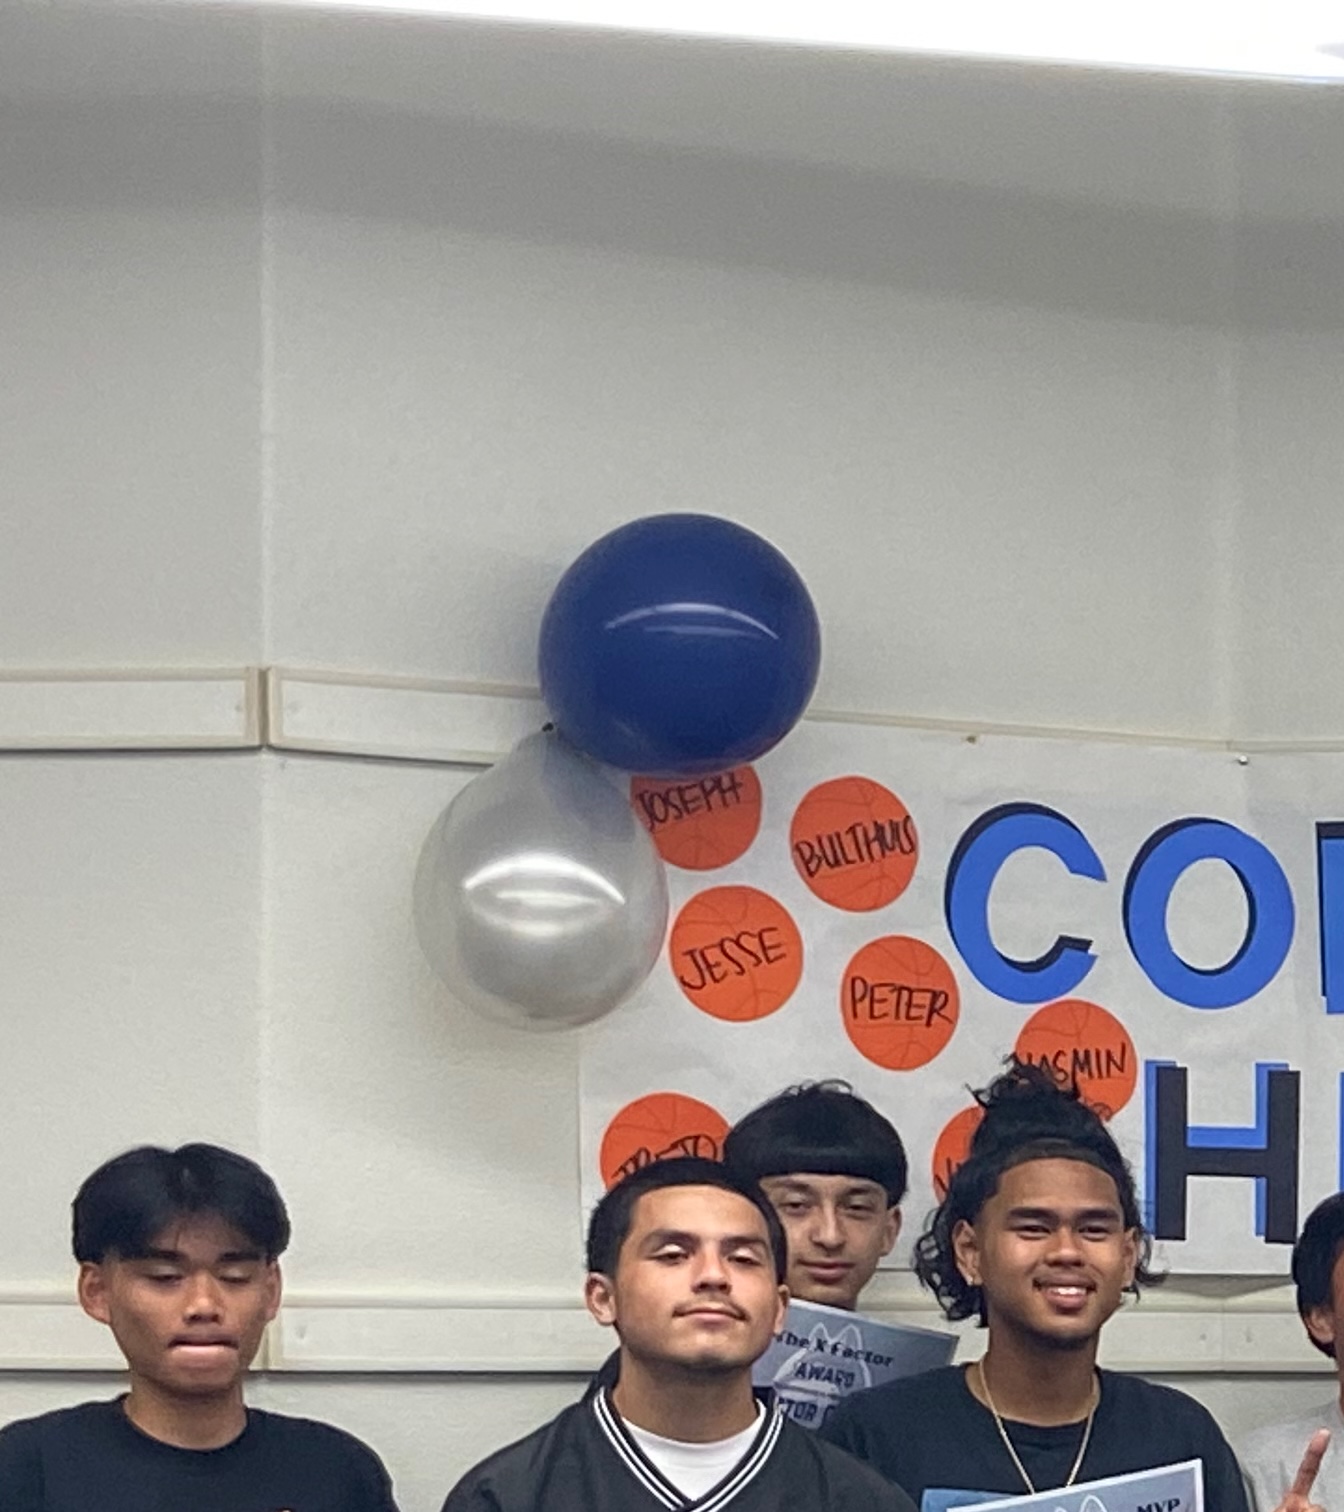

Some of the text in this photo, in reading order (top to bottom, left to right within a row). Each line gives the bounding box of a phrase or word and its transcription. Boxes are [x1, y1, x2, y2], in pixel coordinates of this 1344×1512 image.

[635, 771, 743, 832] JOSEPH
[680, 926, 787, 992] JESSE
[850, 976, 953, 1028] PETER
[1024, 1041, 1127, 1084] ASMIN
